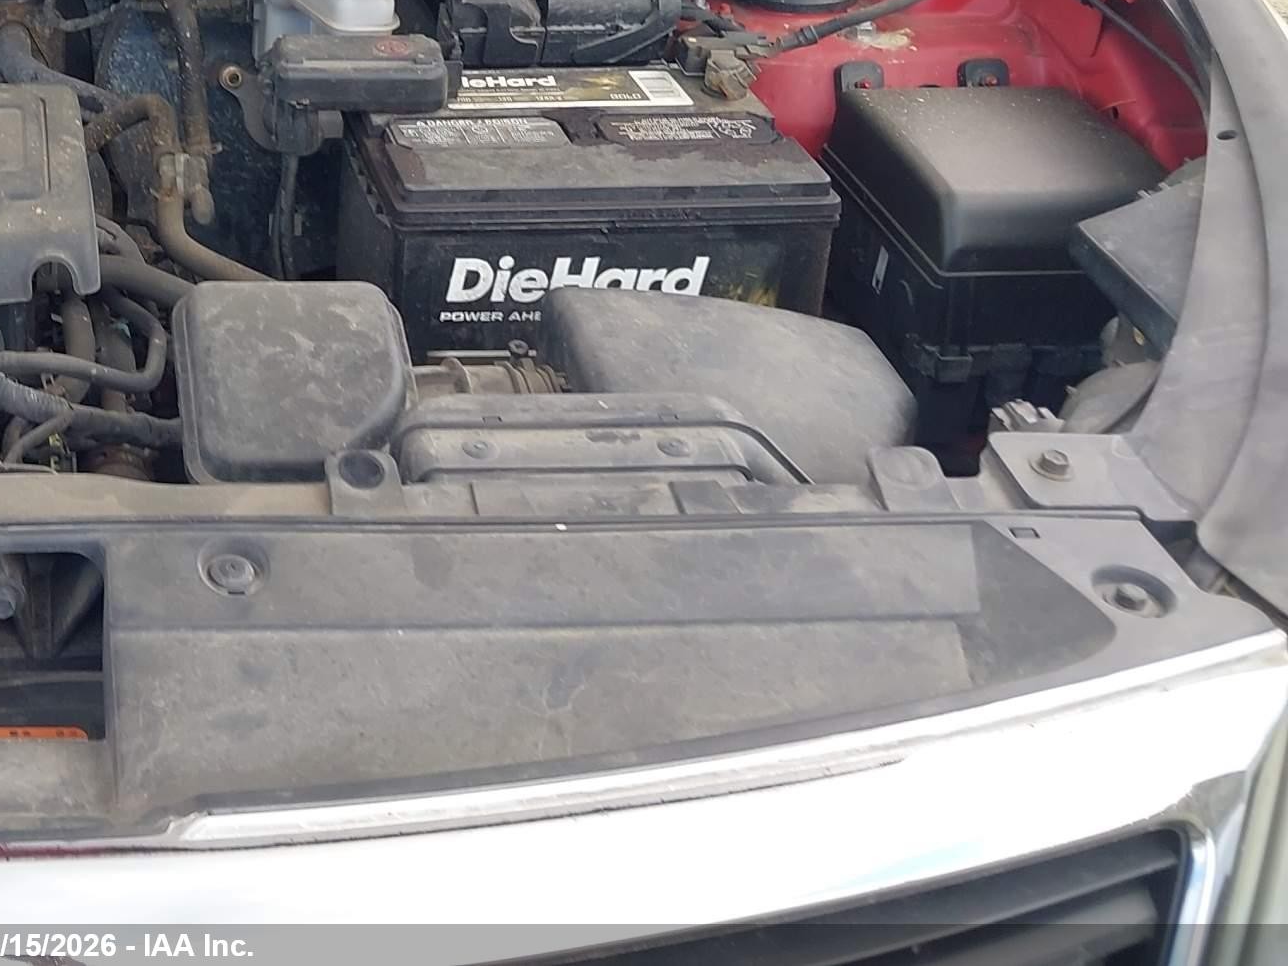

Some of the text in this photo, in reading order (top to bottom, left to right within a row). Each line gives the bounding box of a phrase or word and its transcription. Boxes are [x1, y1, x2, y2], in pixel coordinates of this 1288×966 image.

[461, 74, 557, 89] ieHard
[445, 255, 710, 303] DieHard
[439, 311, 504, 323] POWER
